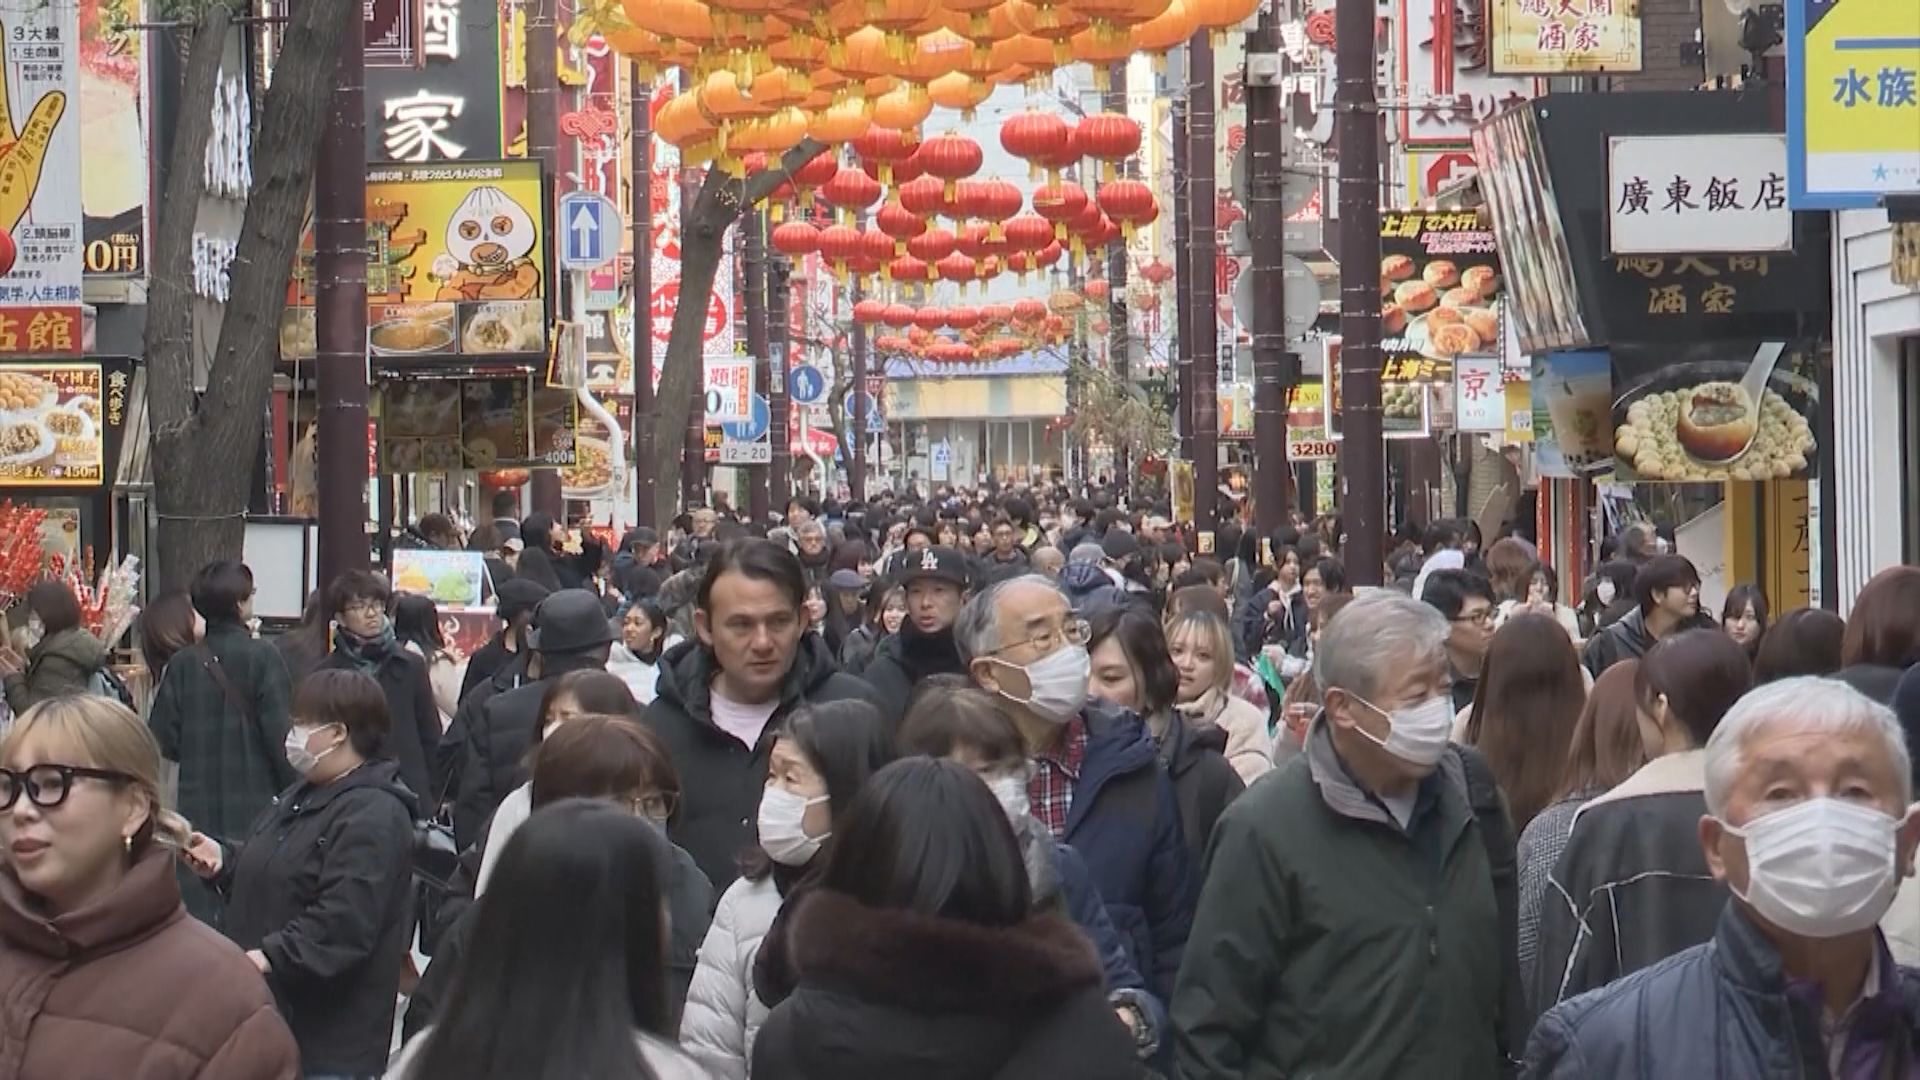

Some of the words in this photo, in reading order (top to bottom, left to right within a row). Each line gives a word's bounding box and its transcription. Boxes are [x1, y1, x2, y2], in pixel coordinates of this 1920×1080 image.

[1538, 22, 1599, 51] 酒家
[1832, 66, 1917, 108] 水族
[1616, 172, 1787, 215] 廣東飯店
[82, 240, 138, 271] 0円
[1648, 282, 1737, 313] 酒家
[1291, 440, 1337, 457] 3280
[920, 548, 938, 569] LA
